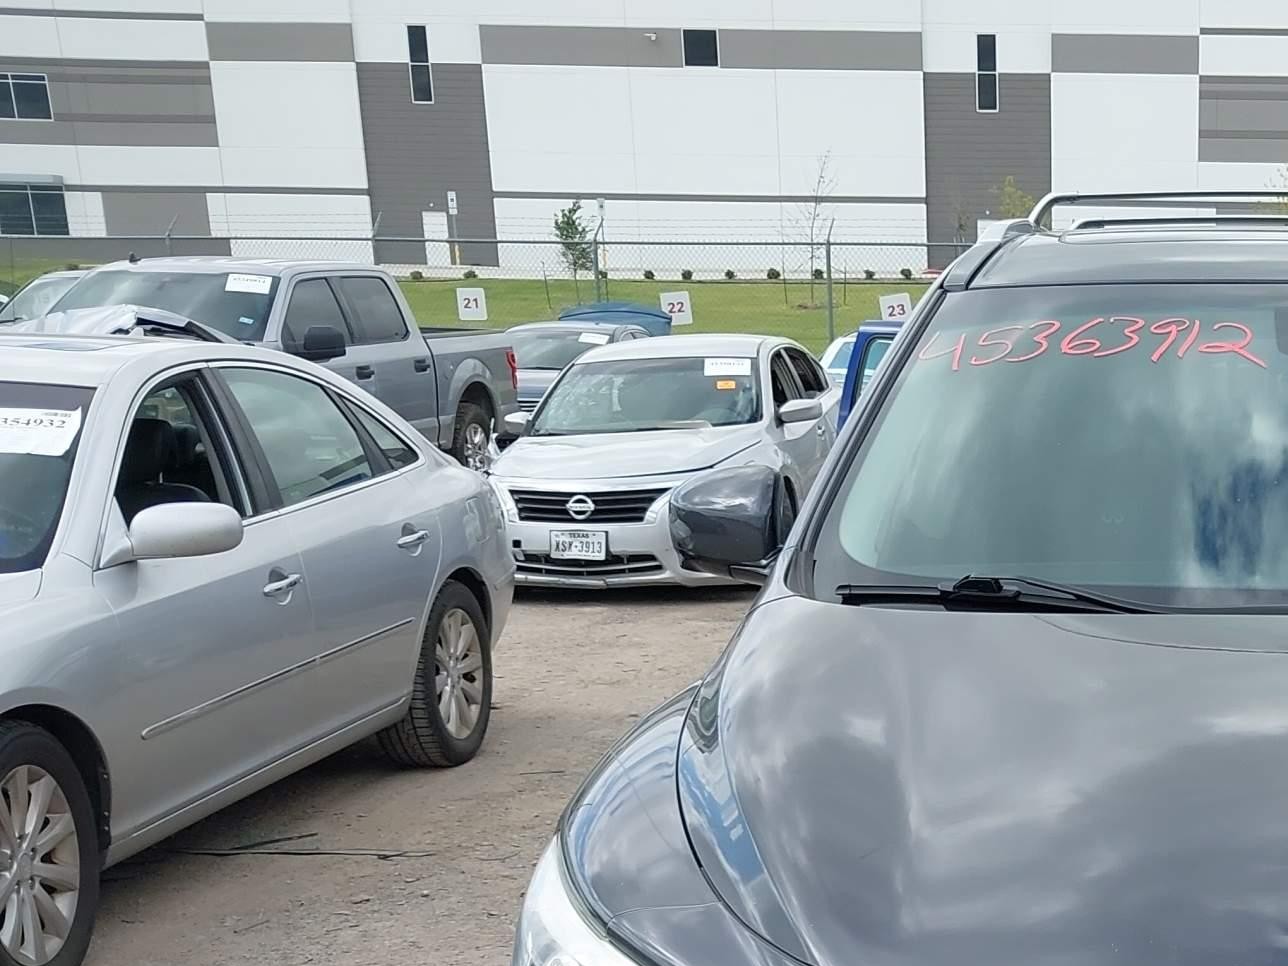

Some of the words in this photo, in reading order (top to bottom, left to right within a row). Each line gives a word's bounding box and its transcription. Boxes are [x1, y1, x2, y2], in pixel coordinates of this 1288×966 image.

[463, 298, 479, 309] 21
[668, 301, 685, 314] 22
[887, 303, 906, 317] 23
[919, 316, 1268, 371] 45363912
